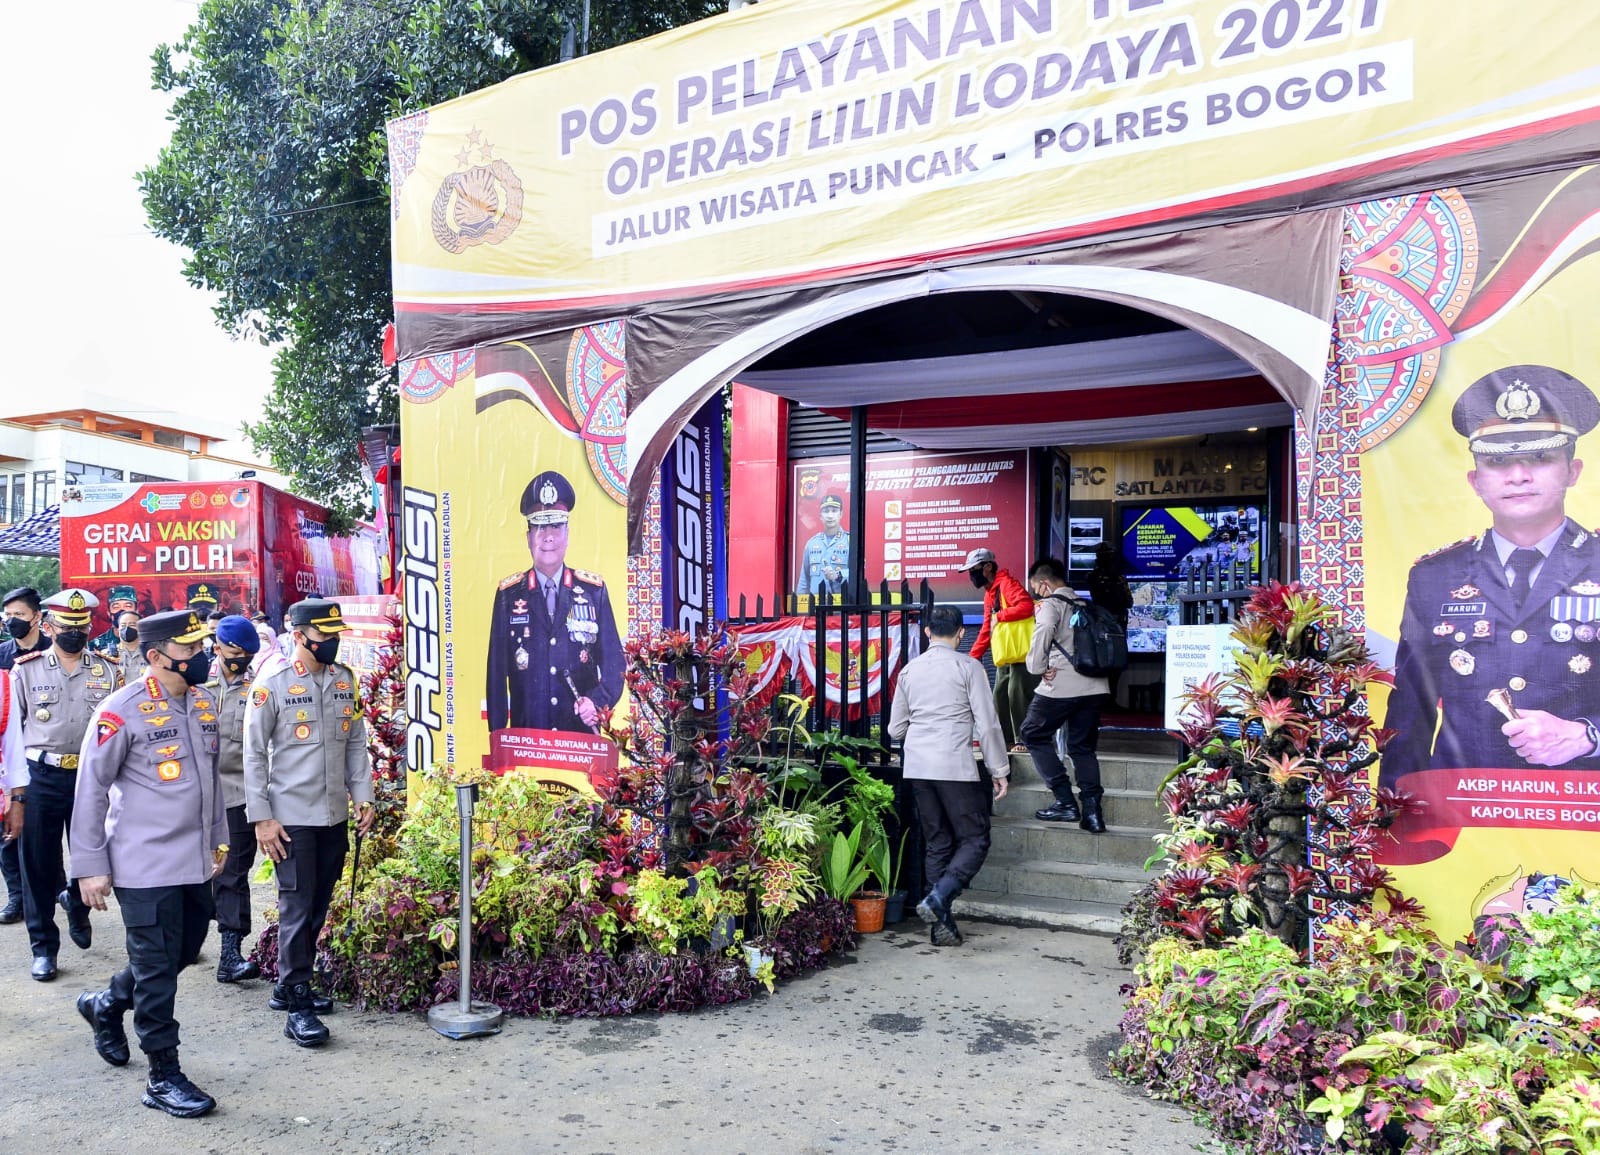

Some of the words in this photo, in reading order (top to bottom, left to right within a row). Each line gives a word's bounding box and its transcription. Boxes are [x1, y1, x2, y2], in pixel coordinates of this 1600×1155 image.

[559, 88, 657, 156] POS
[677, 0, 1053, 125] PELAYANAN
[606, 122, 791, 195] OPERASI
[807, 81, 936, 150] LILIN
[954, 22, 1197, 118] LODAYA
[1219, 0, 1380, 60] 2021
[604, 207, 691, 246] JALUR
[700, 180, 818, 225] WISATA
[828, 143, 980, 198] PUNCAK
[1034, 101, 1188, 159] POLRES
[1206, 60, 1387, 127] BOGOR
[703, 426, 711, 492] BERKEADILAN
[915, 463, 966, 478] PELANGGARAN
[967, 462, 987, 473] LALU
[987, 460, 1015, 471] LINTAS
[875, 477, 912, 491] SAFETY
[913, 475, 940, 488] ZERO
[943, 472, 998, 487] ACCIDENT
[1115, 477, 1226, 496] SATLANTAS
[83, 524, 150, 544] GERAI
[157, 520, 236, 541] VAKSIN
[442, 492, 451, 559] BERKEADILAN
[705, 493, 713, 565] TRANSPARANSI
[86, 547, 128, 573] TNI
[155, 544, 233, 571] POLRI
[296, 570, 325, 594] GERAI
[444, 561, 453, 635] TRANSPARANSI
[1447, 605, 1477, 613] HARUN
[404, 486, 441, 776] PRESISI
[445, 642, 454, 725] RESPONSIBILITAS
[285, 696, 313, 706] HARUN
[446, 733, 455, 775] DIKTIF
[500, 735, 520, 744] IRJEN
[521, 737, 537, 745] POL.
[554, 739, 591, 751] SUNTANA,
[513, 749, 546, 760] KAPOLDA
[548, 754, 567, 762] JAWA
[568, 755, 593, 764] BARAT
[550, 784, 571, 796] BARA
[1457, 778, 1498, 791] AKBP
[1501, 780, 1559, 796] HARUN,
[1471, 806, 1556, 821] KAPOLRES
